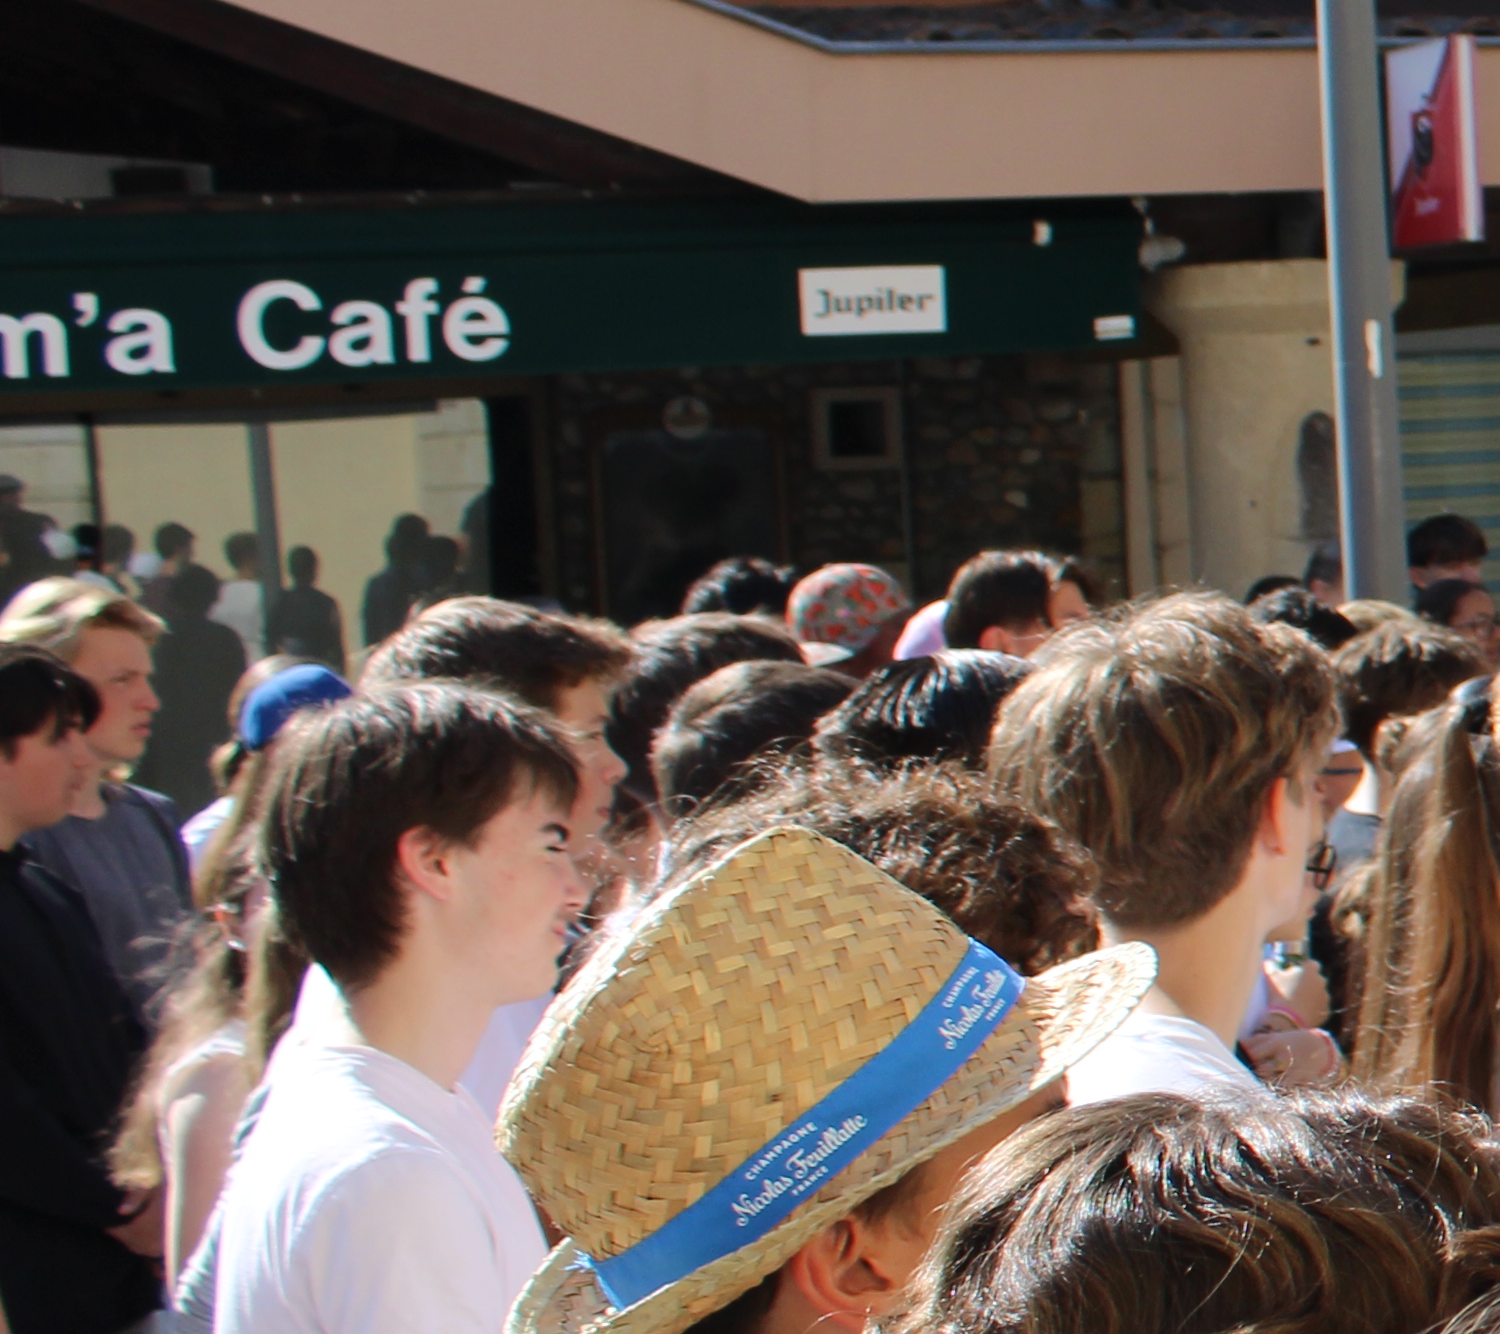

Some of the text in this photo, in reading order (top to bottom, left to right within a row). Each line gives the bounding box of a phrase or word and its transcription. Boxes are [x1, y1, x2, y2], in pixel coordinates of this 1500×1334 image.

[236, 276, 511, 370] Café
[814, 288, 935, 318] Jupiler
[730, 1115, 868, 1227] Nicolas Feuillatte
[744, 1121, 818, 1181] CHAMPAGNE
[790, 1165, 830, 1196] FRANCE
